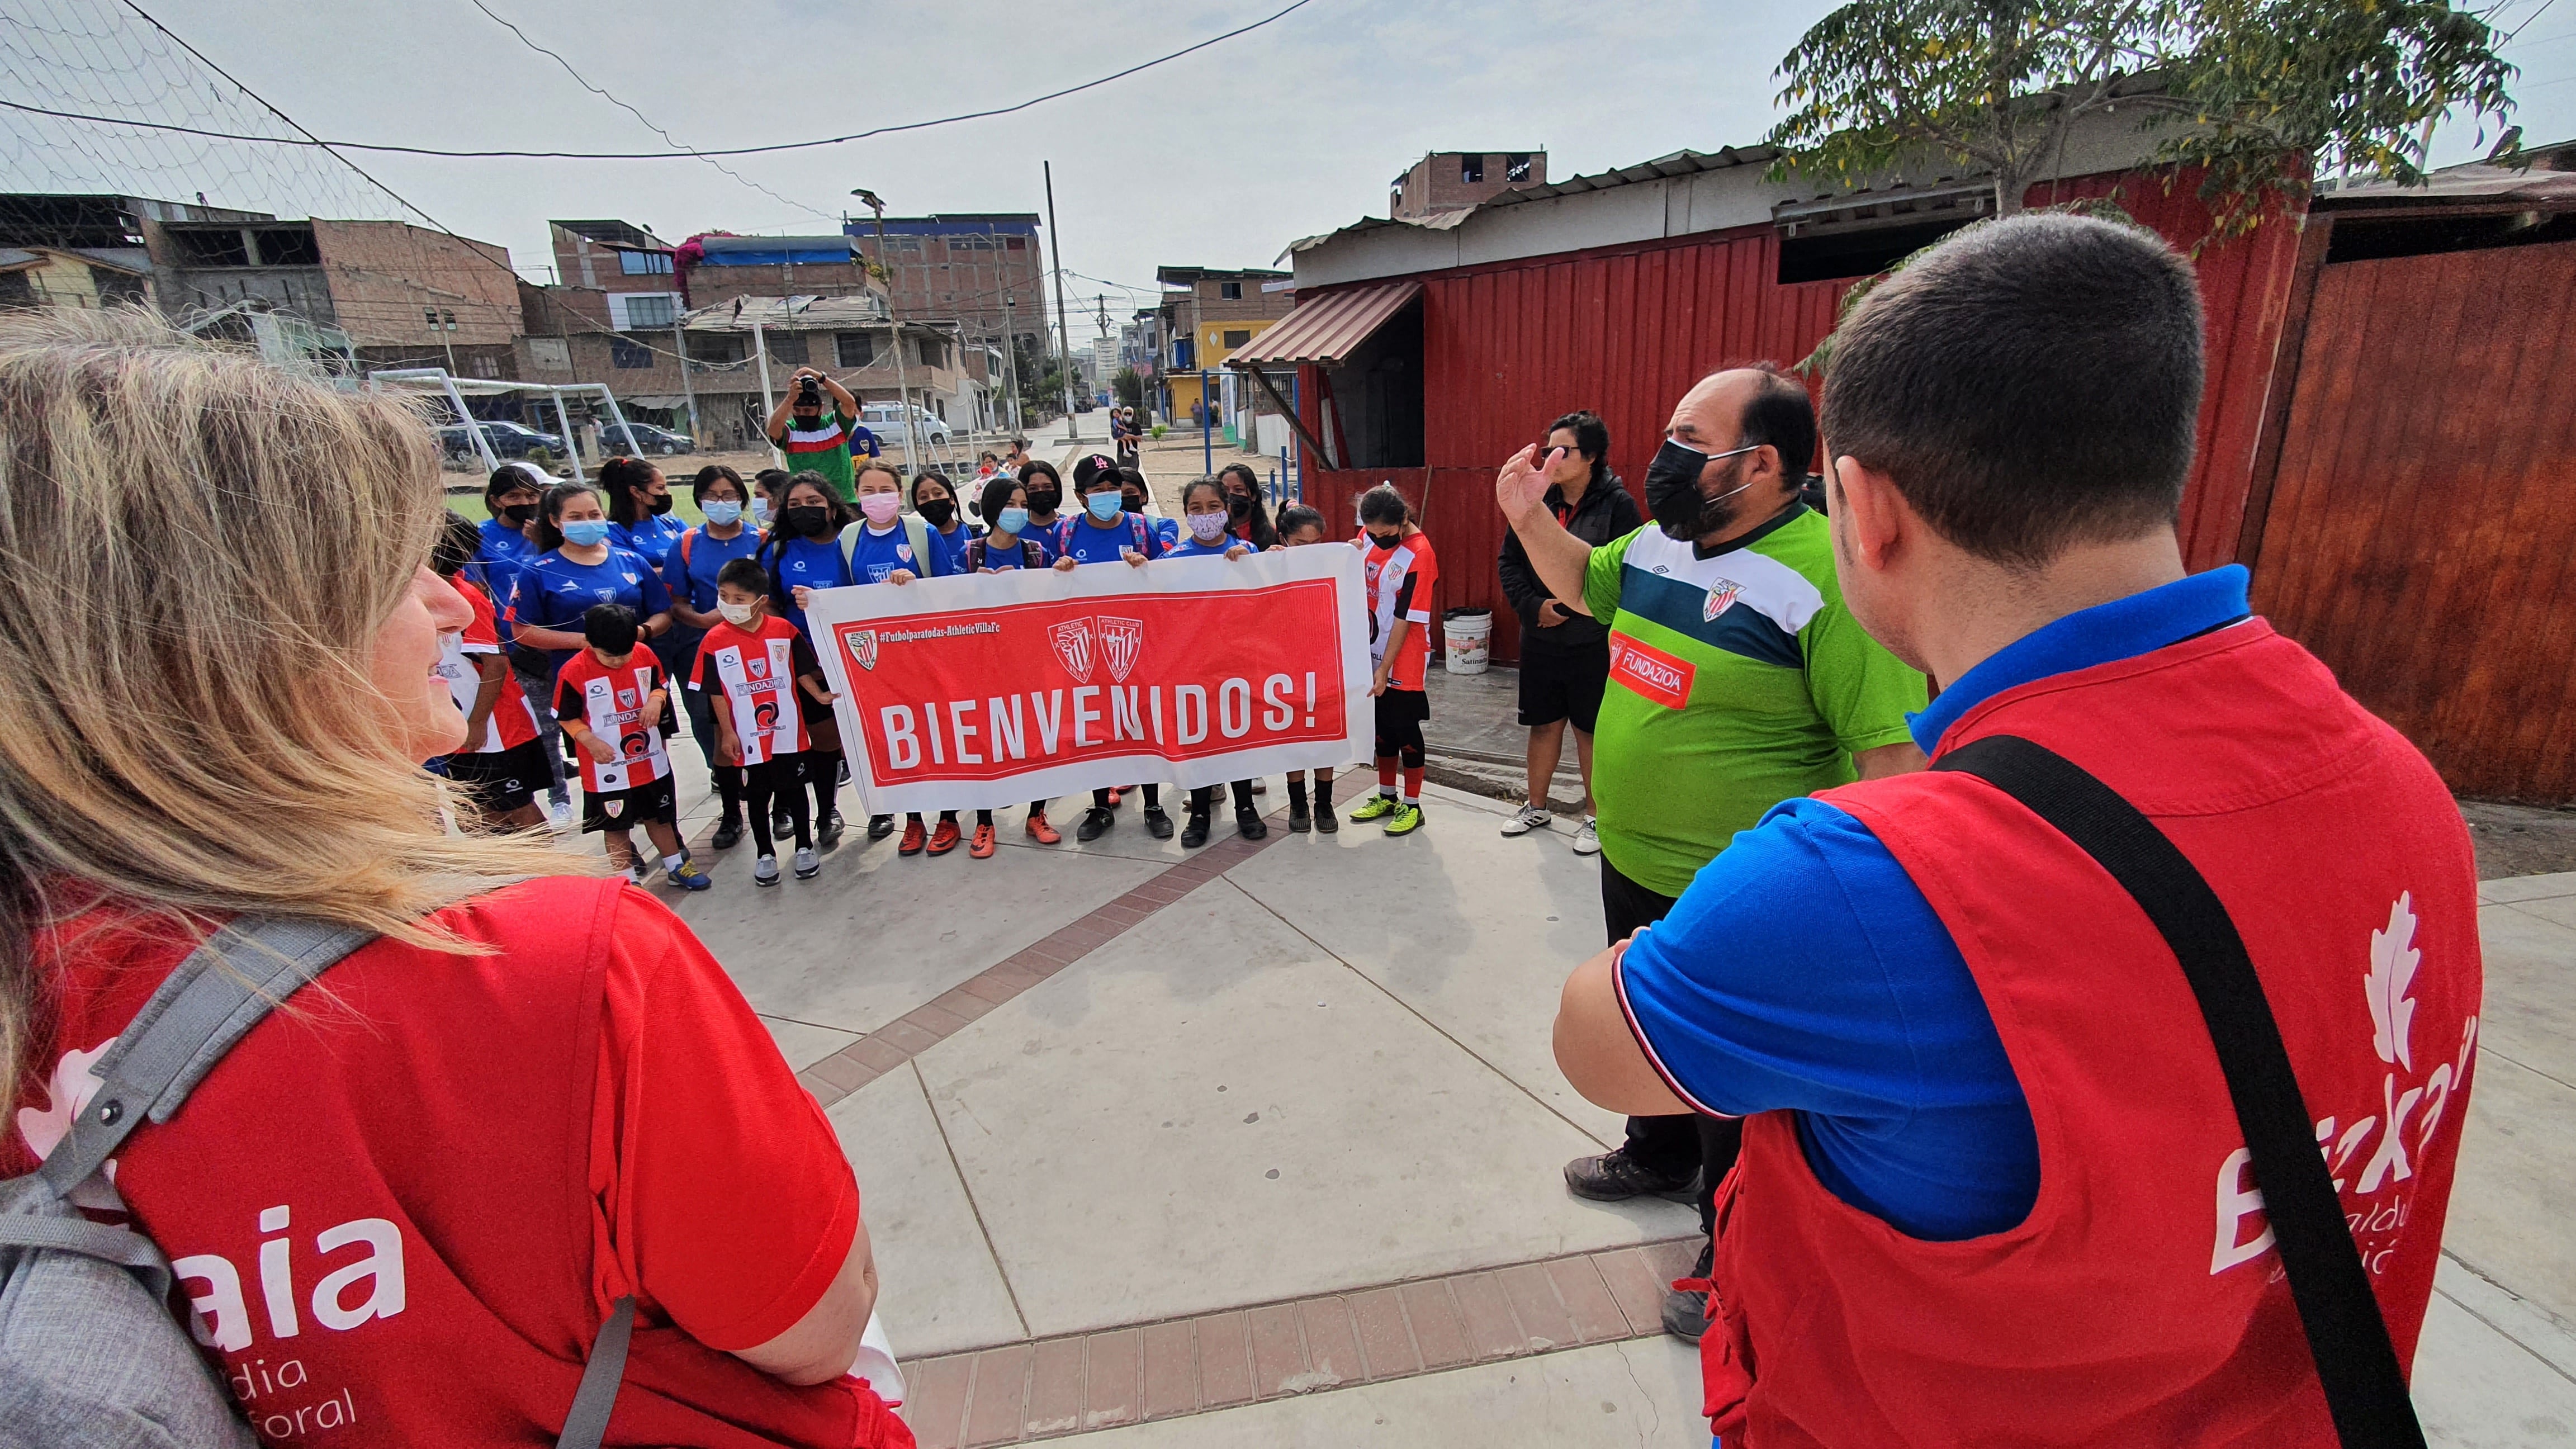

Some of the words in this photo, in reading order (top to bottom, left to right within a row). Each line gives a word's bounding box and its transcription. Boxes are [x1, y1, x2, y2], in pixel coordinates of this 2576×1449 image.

[1092, 455, 1109, 468] LA
[879, 622, 1000, 643] #Futbolparatodas-AthleticVillaFc
[1058, 621, 1083, 632] ATHLETIC
[1068, 661, 1086, 679] VILLA
[1086, 659, 1092, 674] FC
[1111, 661, 1129, 679] BILBAO
[1623, 652, 1680, 691] FUNDAZIOA
[880, 672, 1316, 770] BIENVENIDOS!
